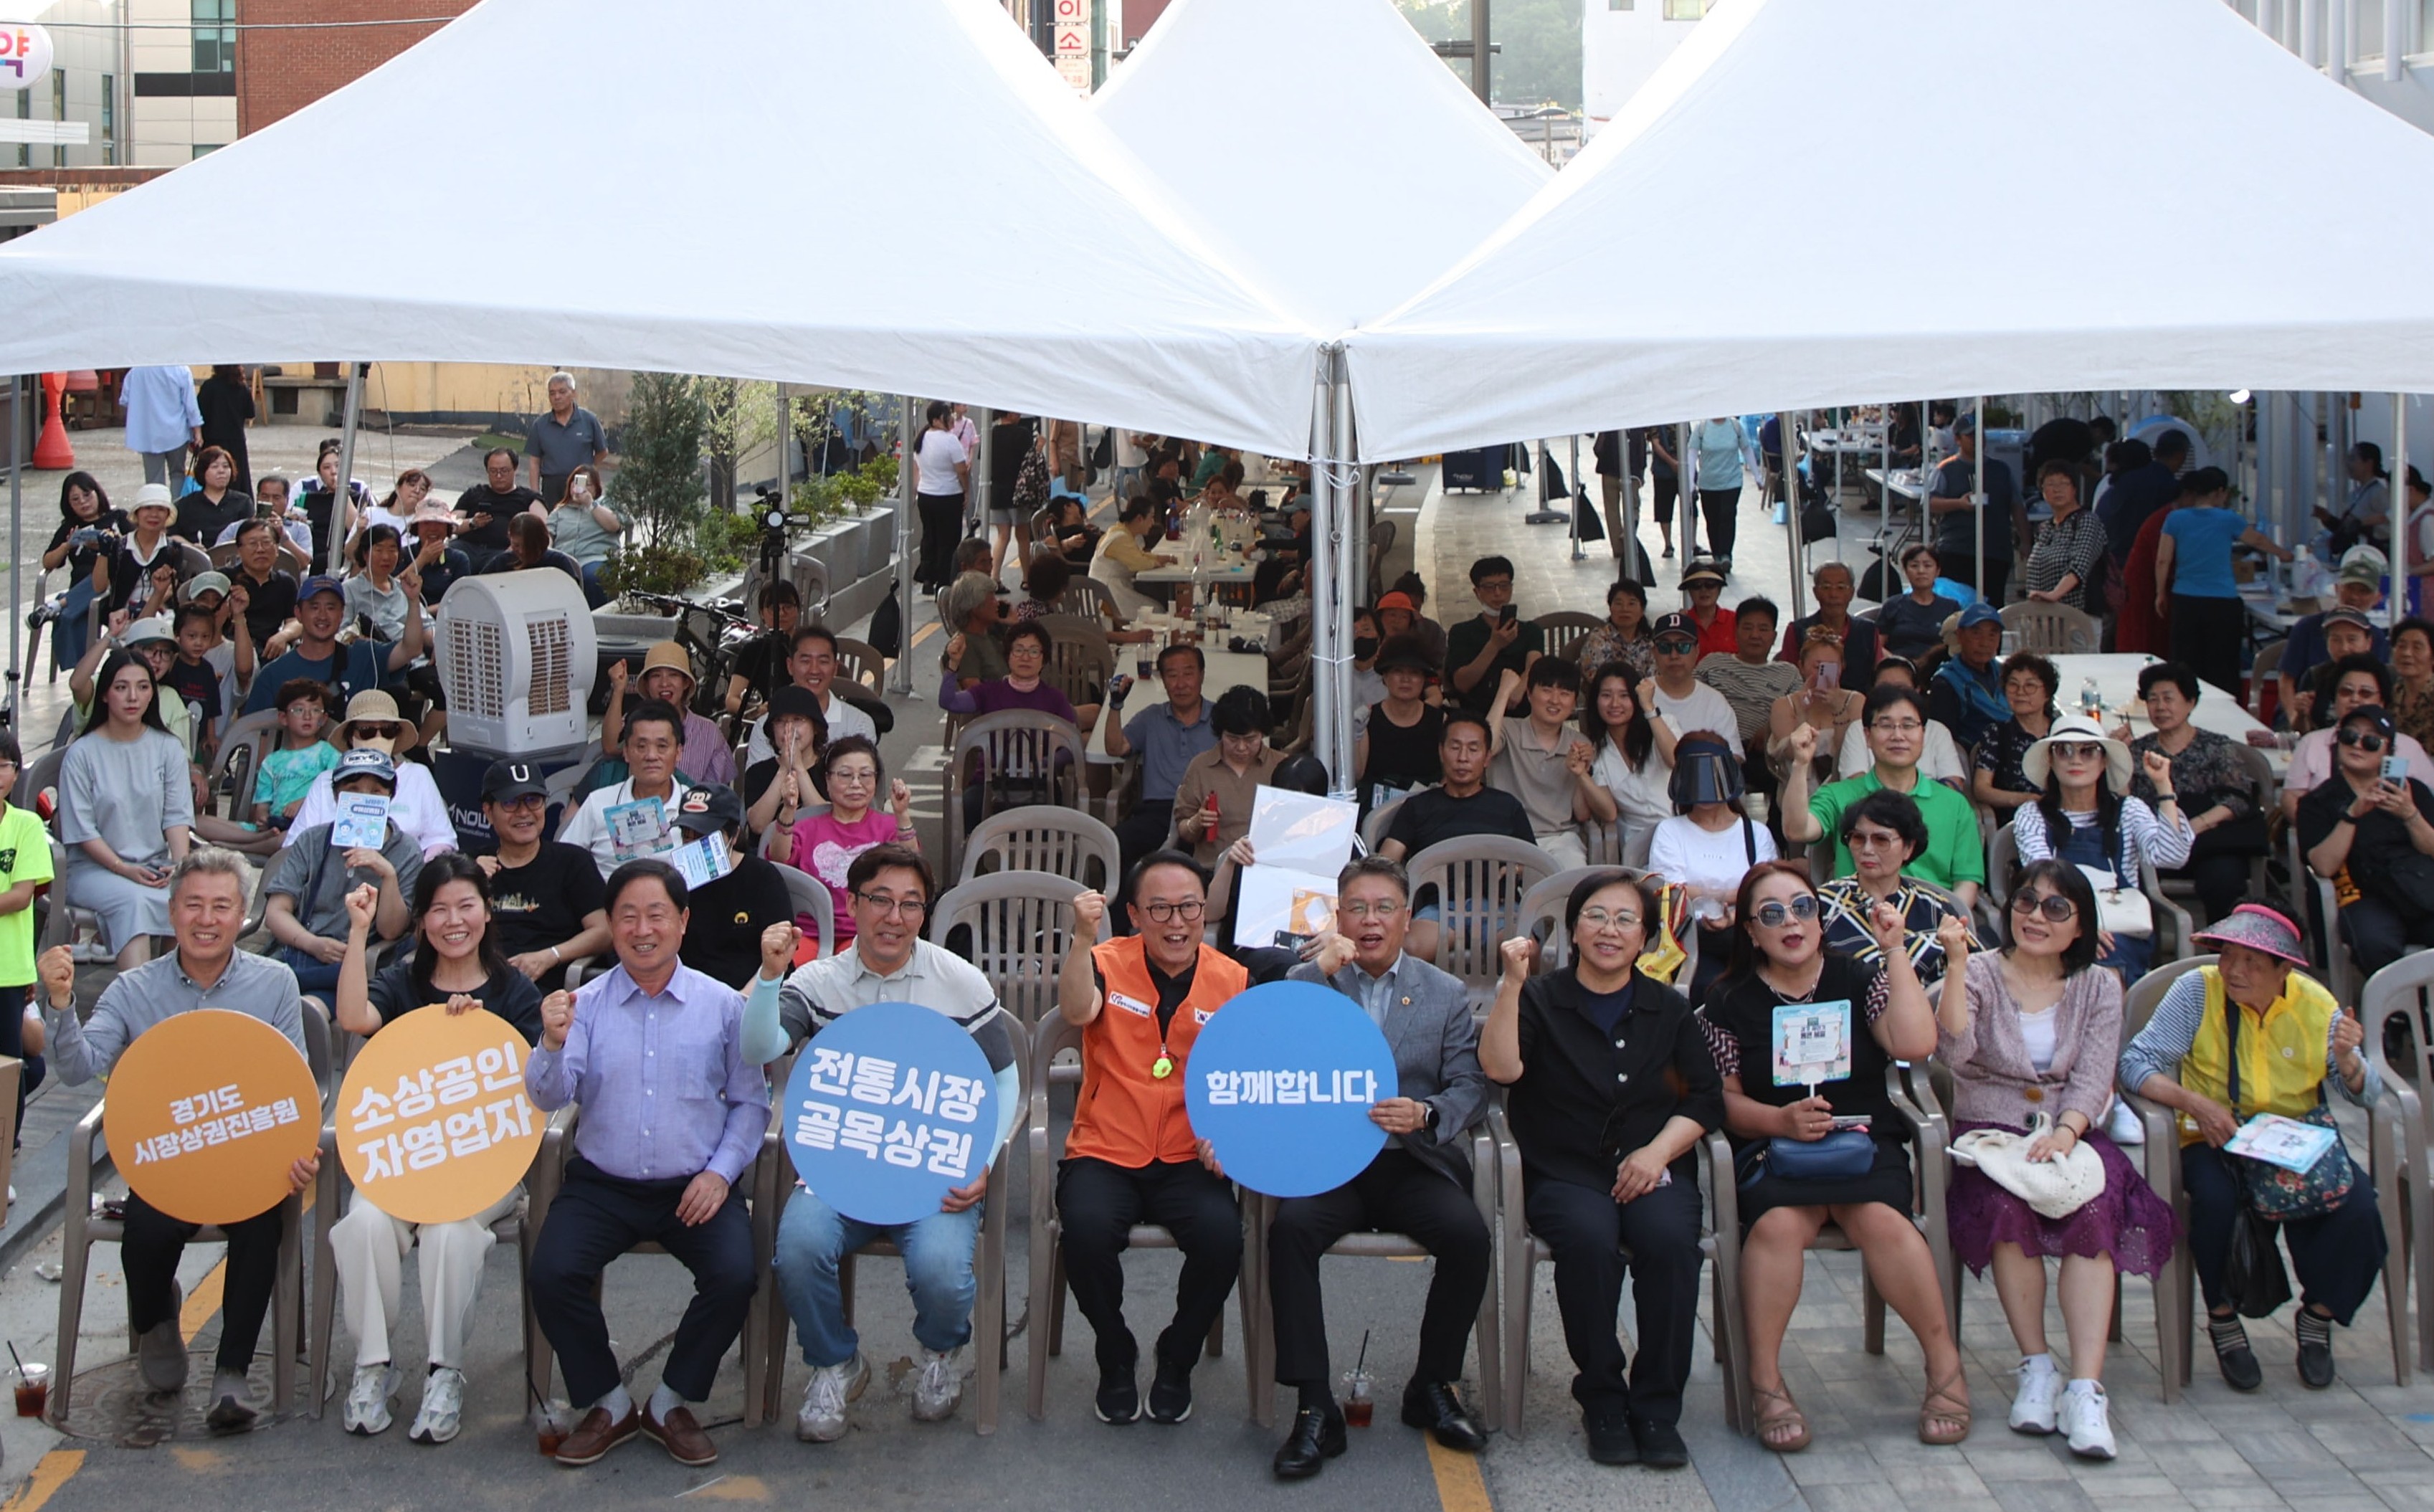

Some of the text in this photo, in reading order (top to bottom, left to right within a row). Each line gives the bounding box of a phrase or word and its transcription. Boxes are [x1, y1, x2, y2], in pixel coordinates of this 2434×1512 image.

[1669, 614, 1680, 627] D
[510, 764, 530, 782] U
[455, 807, 491, 829] NOW
[170, 1084, 244, 1124] 경기도
[351, 1041, 523, 1133] 소상공인
[810, 1048, 986, 1123] 전통시장
[1206, 1070, 1378, 1104] 함께합니다
[135, 1098, 300, 1164] 시장상권진흥원
[357, 1093, 533, 1184] 자영업자
[795, 1101, 972, 1178] 골목상권
